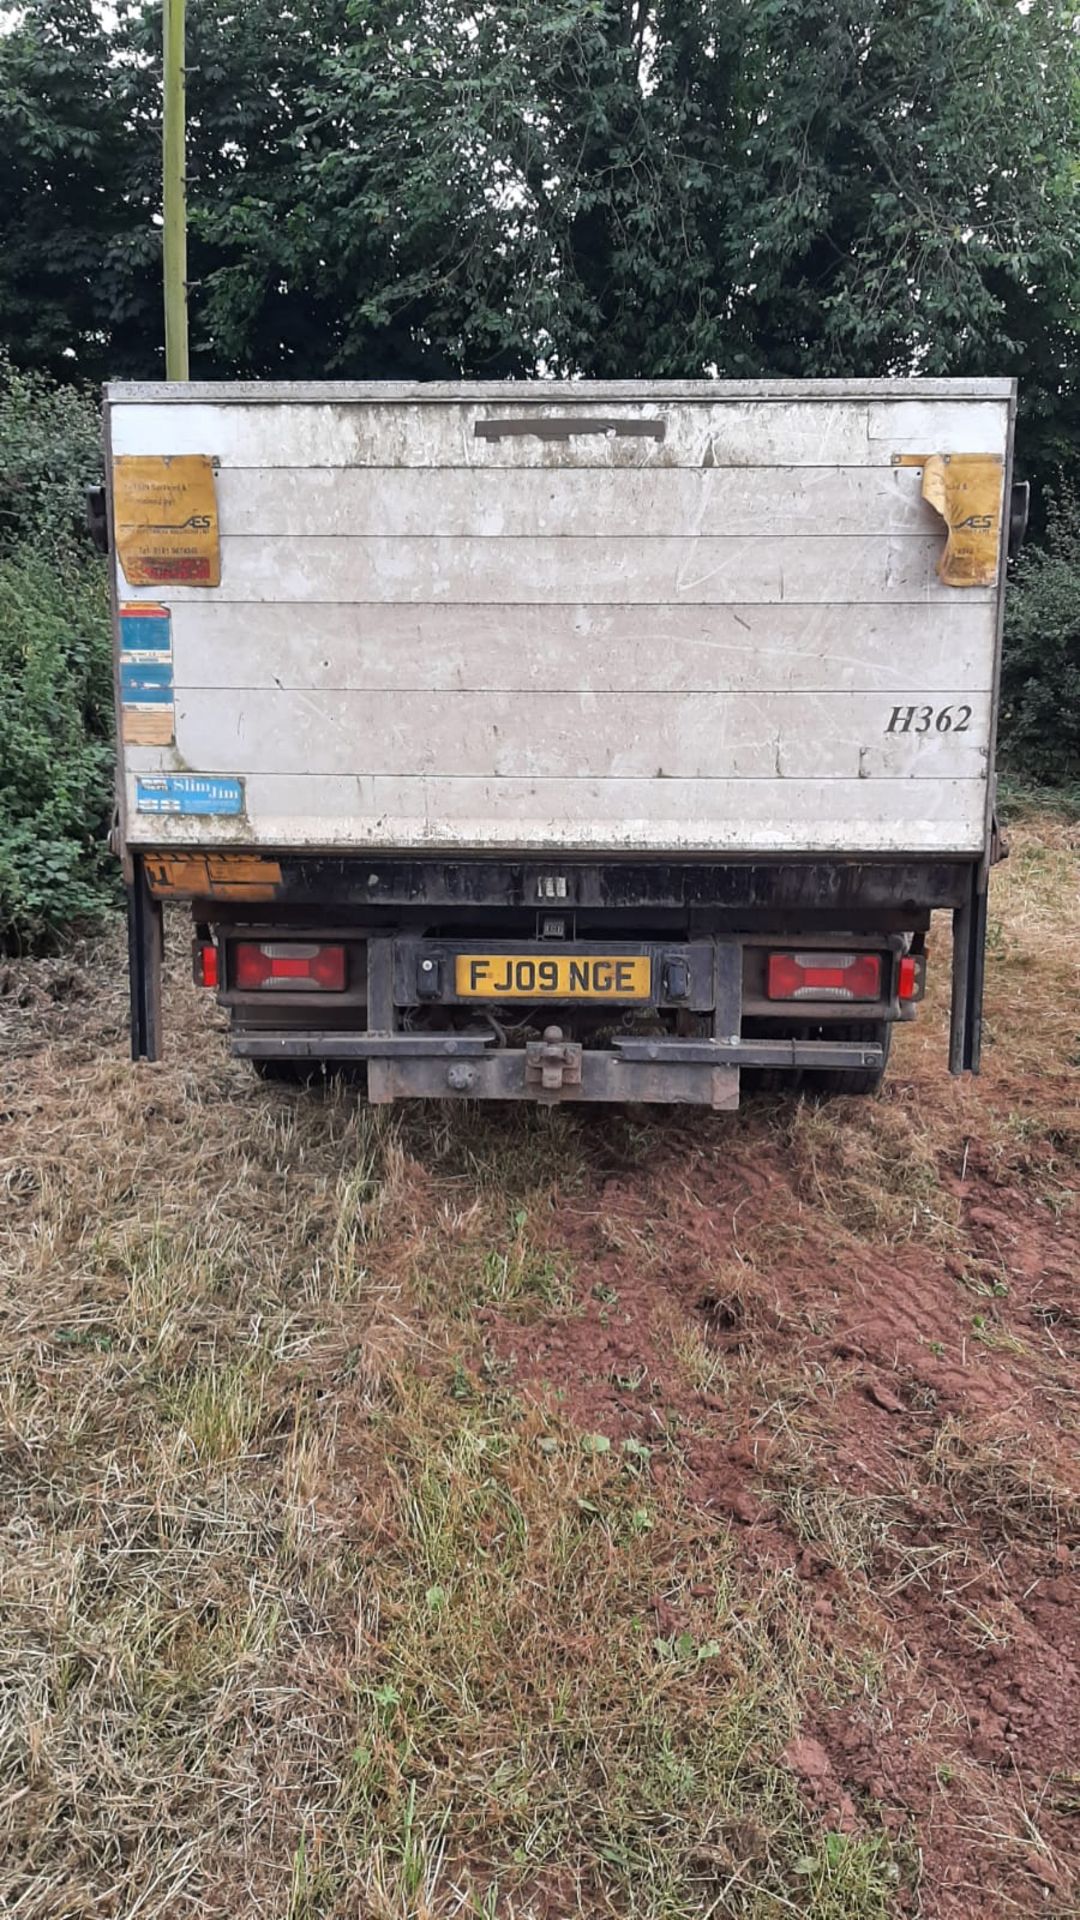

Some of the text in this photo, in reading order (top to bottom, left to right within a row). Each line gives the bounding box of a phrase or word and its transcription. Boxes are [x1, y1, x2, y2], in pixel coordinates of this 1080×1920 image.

[884, 705, 973, 733] H362
[173, 778, 210, 792] Slim
[208, 786, 239, 799] Jim
[470, 960, 635, 992] FJ09 NGE
